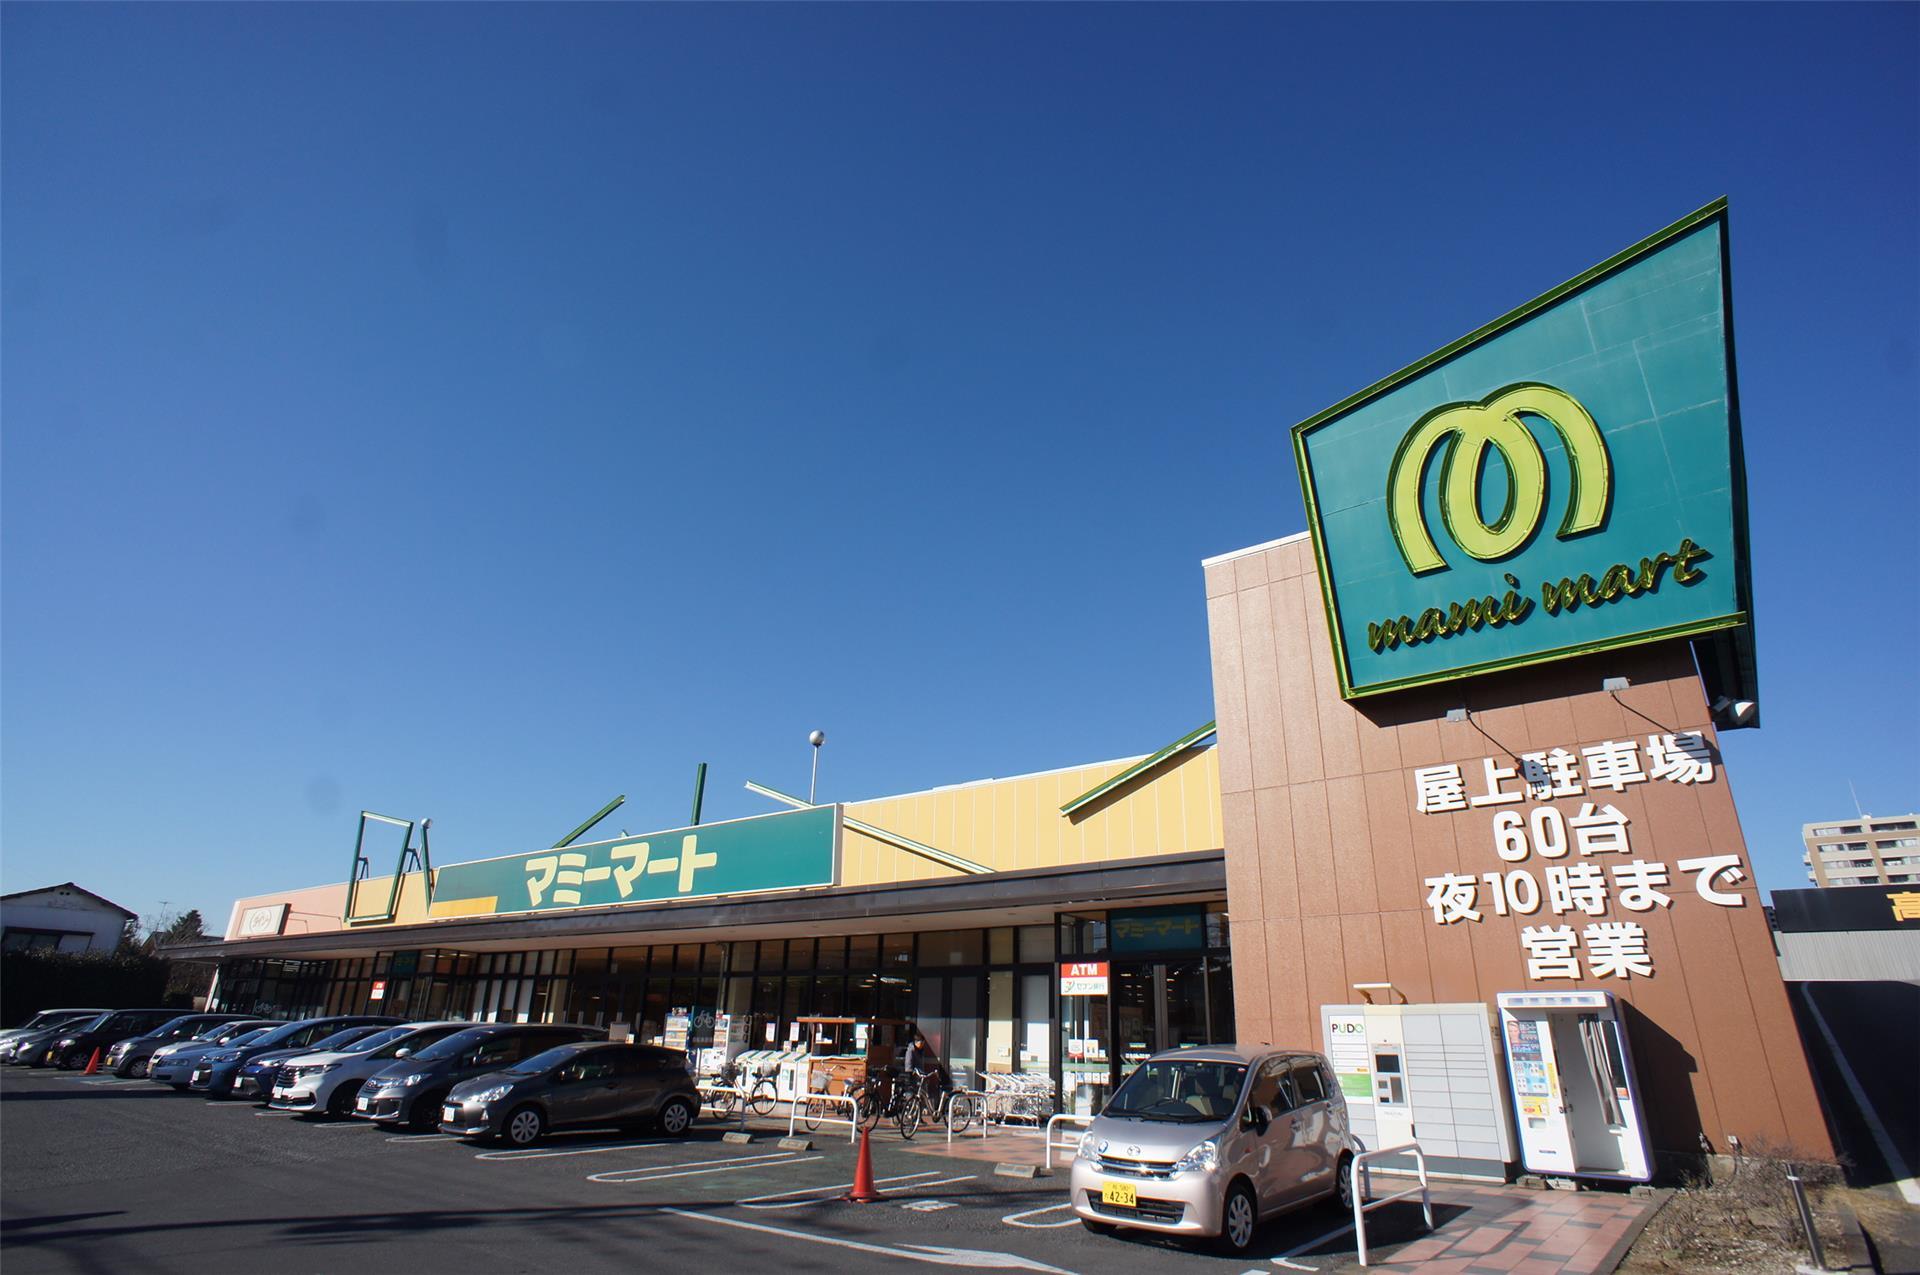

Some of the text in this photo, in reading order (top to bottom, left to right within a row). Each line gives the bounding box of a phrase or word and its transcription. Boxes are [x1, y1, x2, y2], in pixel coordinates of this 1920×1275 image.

[1368, 537, 1713, 652] mami mart
[1415, 731, 1713, 814] 屋上駐車場
[1492, 804, 1631, 861] 60台
[525, 834, 718, 907] マミーマート
[1424, 854, 1747, 925] 夜10時まで
[1114, 918, 1199, 938] マミーマート
[1520, 922, 1654, 979] 営業
[1070, 963, 1098, 976] ATM
